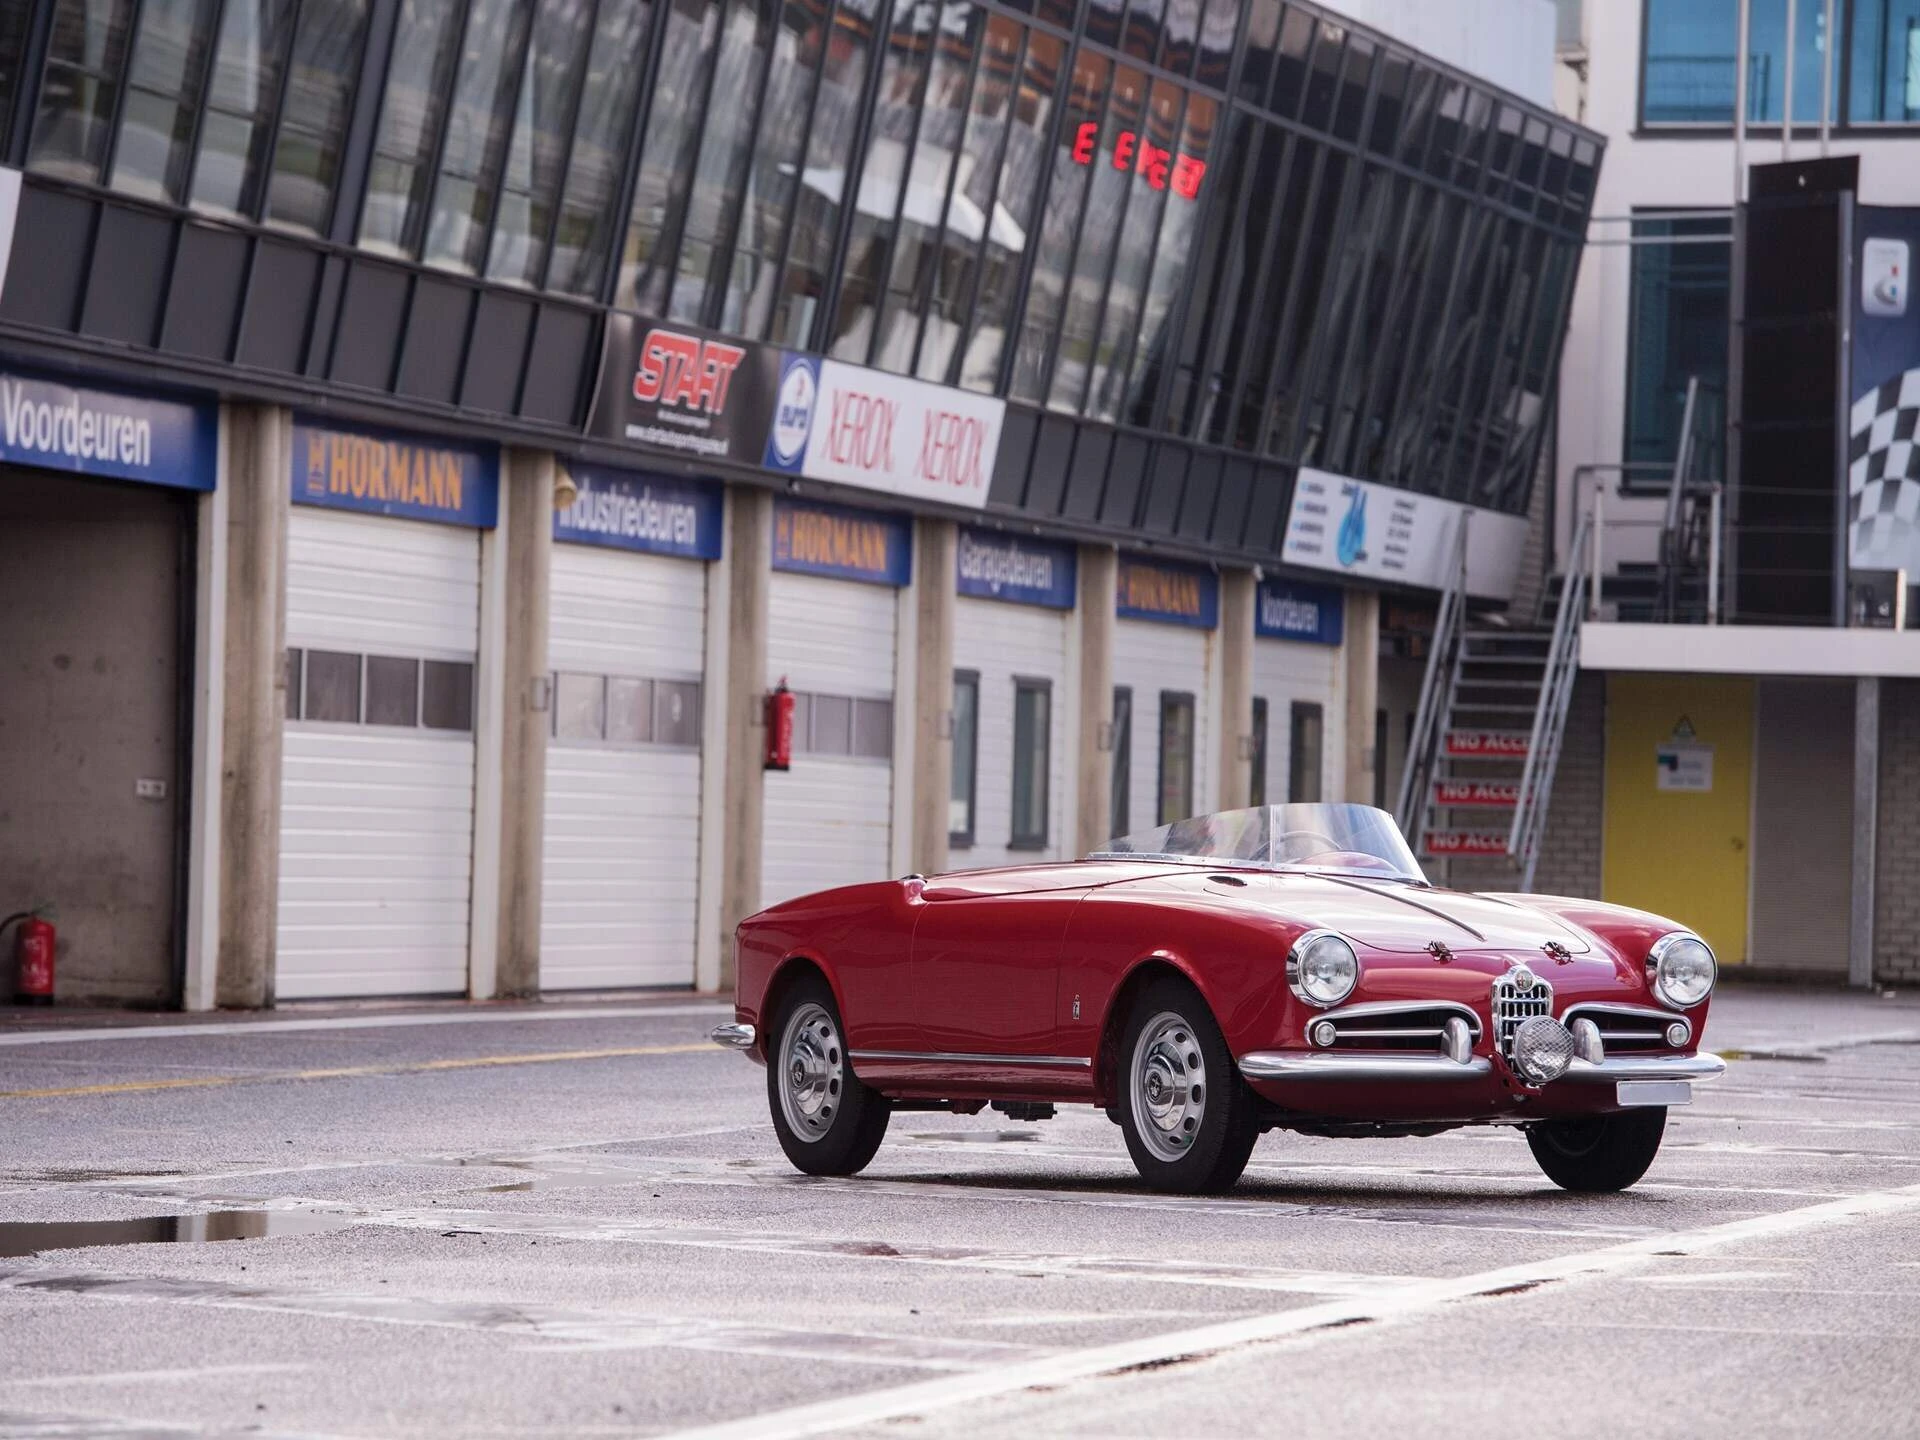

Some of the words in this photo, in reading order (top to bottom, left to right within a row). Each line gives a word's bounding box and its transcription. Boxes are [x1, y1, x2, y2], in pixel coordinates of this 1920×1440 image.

[3, 378, 151, 468] Voordeuren
[1452, 733, 1481, 749] NO
[1442, 782, 1470, 800] NO
[1432, 832, 1460, 849] NO
